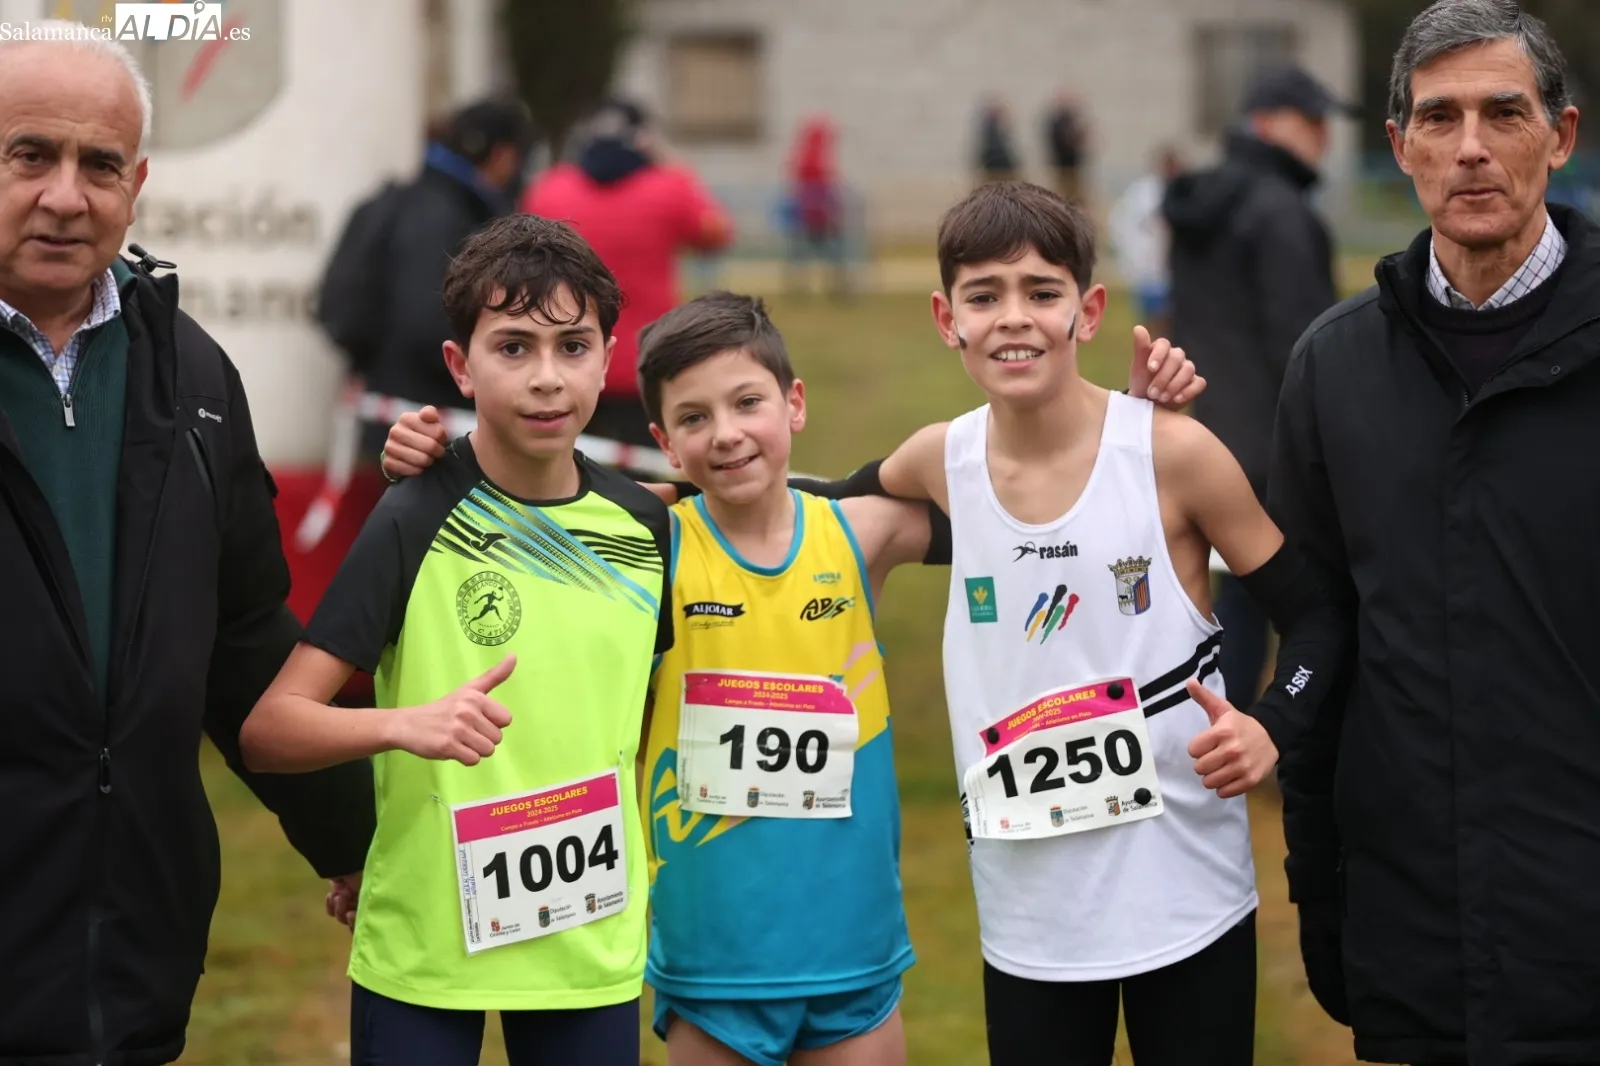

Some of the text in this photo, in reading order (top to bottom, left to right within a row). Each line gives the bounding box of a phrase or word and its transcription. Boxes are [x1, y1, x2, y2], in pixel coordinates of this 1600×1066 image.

[1039, 541, 1078, 559] rasán
[717, 678, 825, 693] JUEGOS ESCOLARES
[1006, 689, 1097, 731] JUEGOS ESCOLARES
[719, 724, 829, 774] 190
[986, 729, 1143, 798] 1250
[490, 786, 588, 817] JUEGOS ESCOLARES
[526, 805, 558, 818] 2024-2025
[501, 822, 518, 832] Campo
[482, 824, 619, 899] 1004
